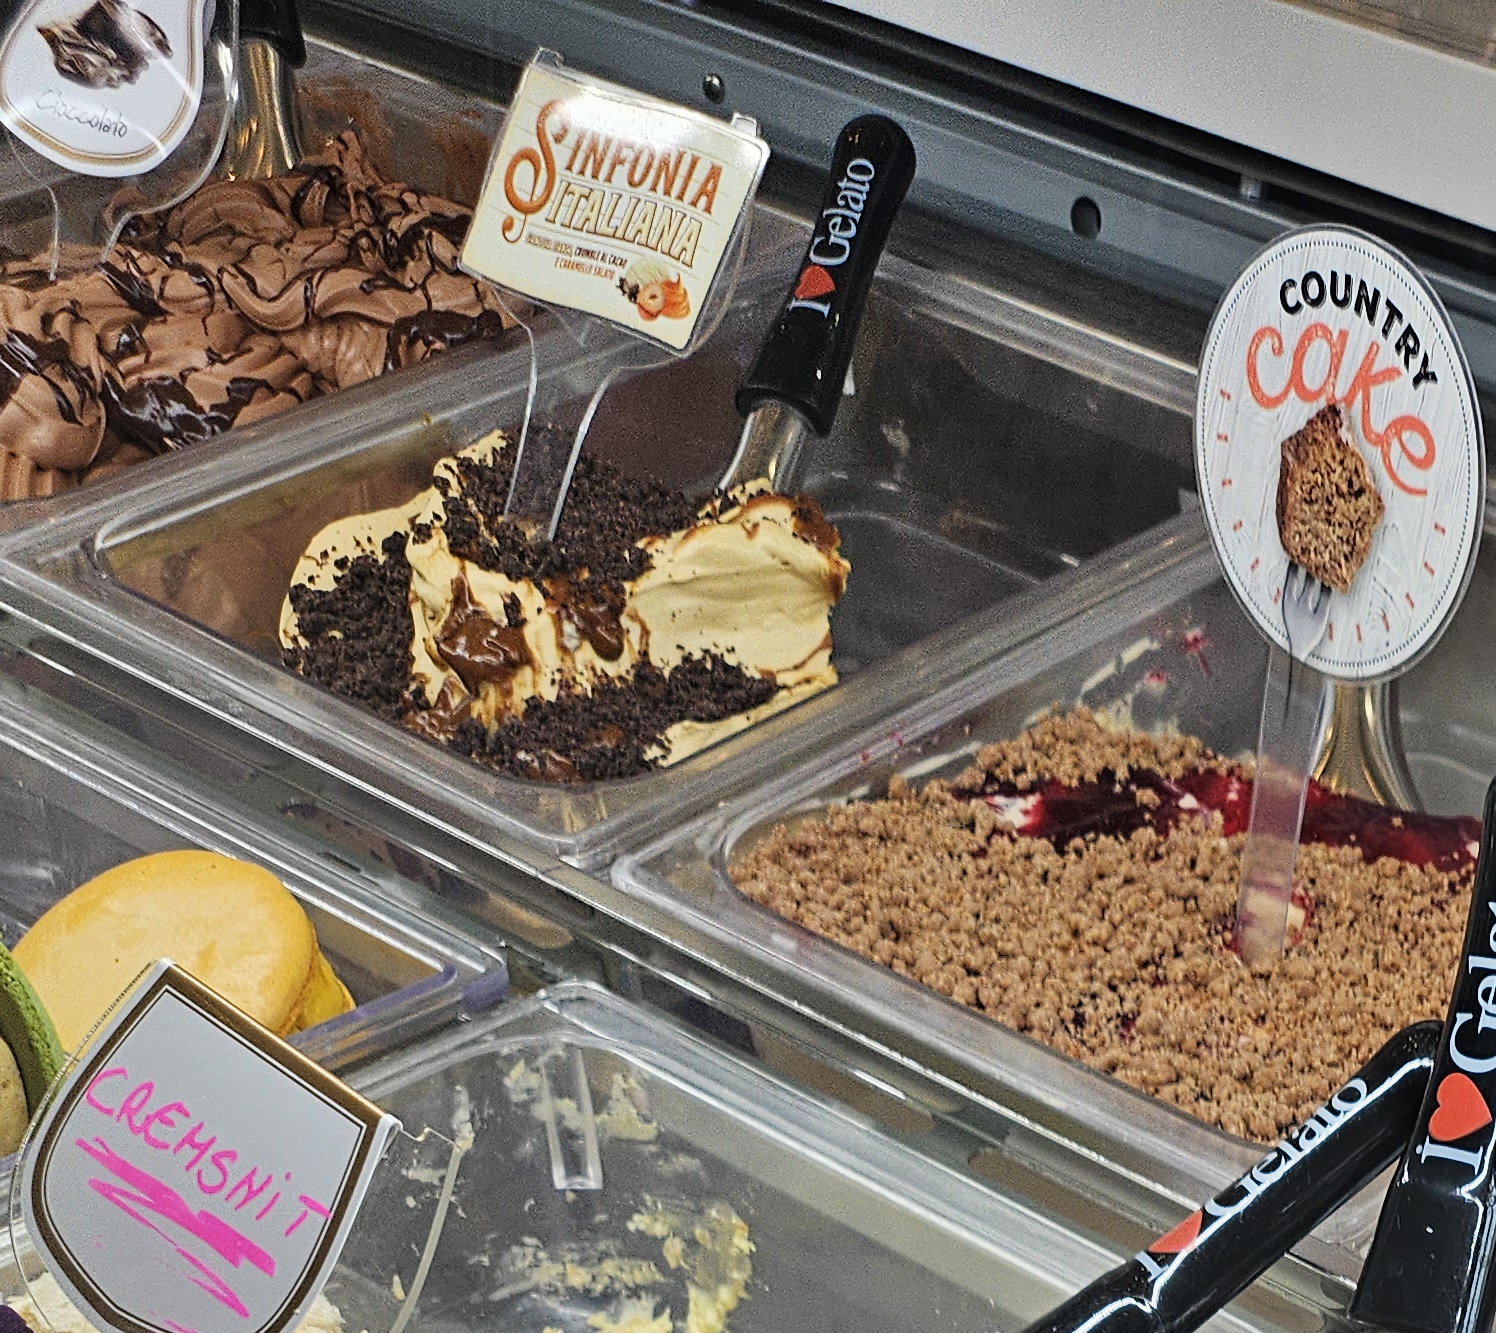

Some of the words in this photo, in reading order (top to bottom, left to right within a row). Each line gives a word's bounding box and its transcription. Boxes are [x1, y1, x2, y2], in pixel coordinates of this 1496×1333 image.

[36, 89, 128, 138] Cioccolato
[502, 99, 723, 243] SINFONIA
[809, 157, 876, 266] Gelato
[545, 179, 703, 269] ITALIANA
[788, 298, 831, 319] I
[1279, 270, 1439, 391] COUNTRY
[1134, 1250, 1169, 1282] I
[1204, 1077, 1368, 1217] Gelato
[1420, 1141, 1483, 1178] I
